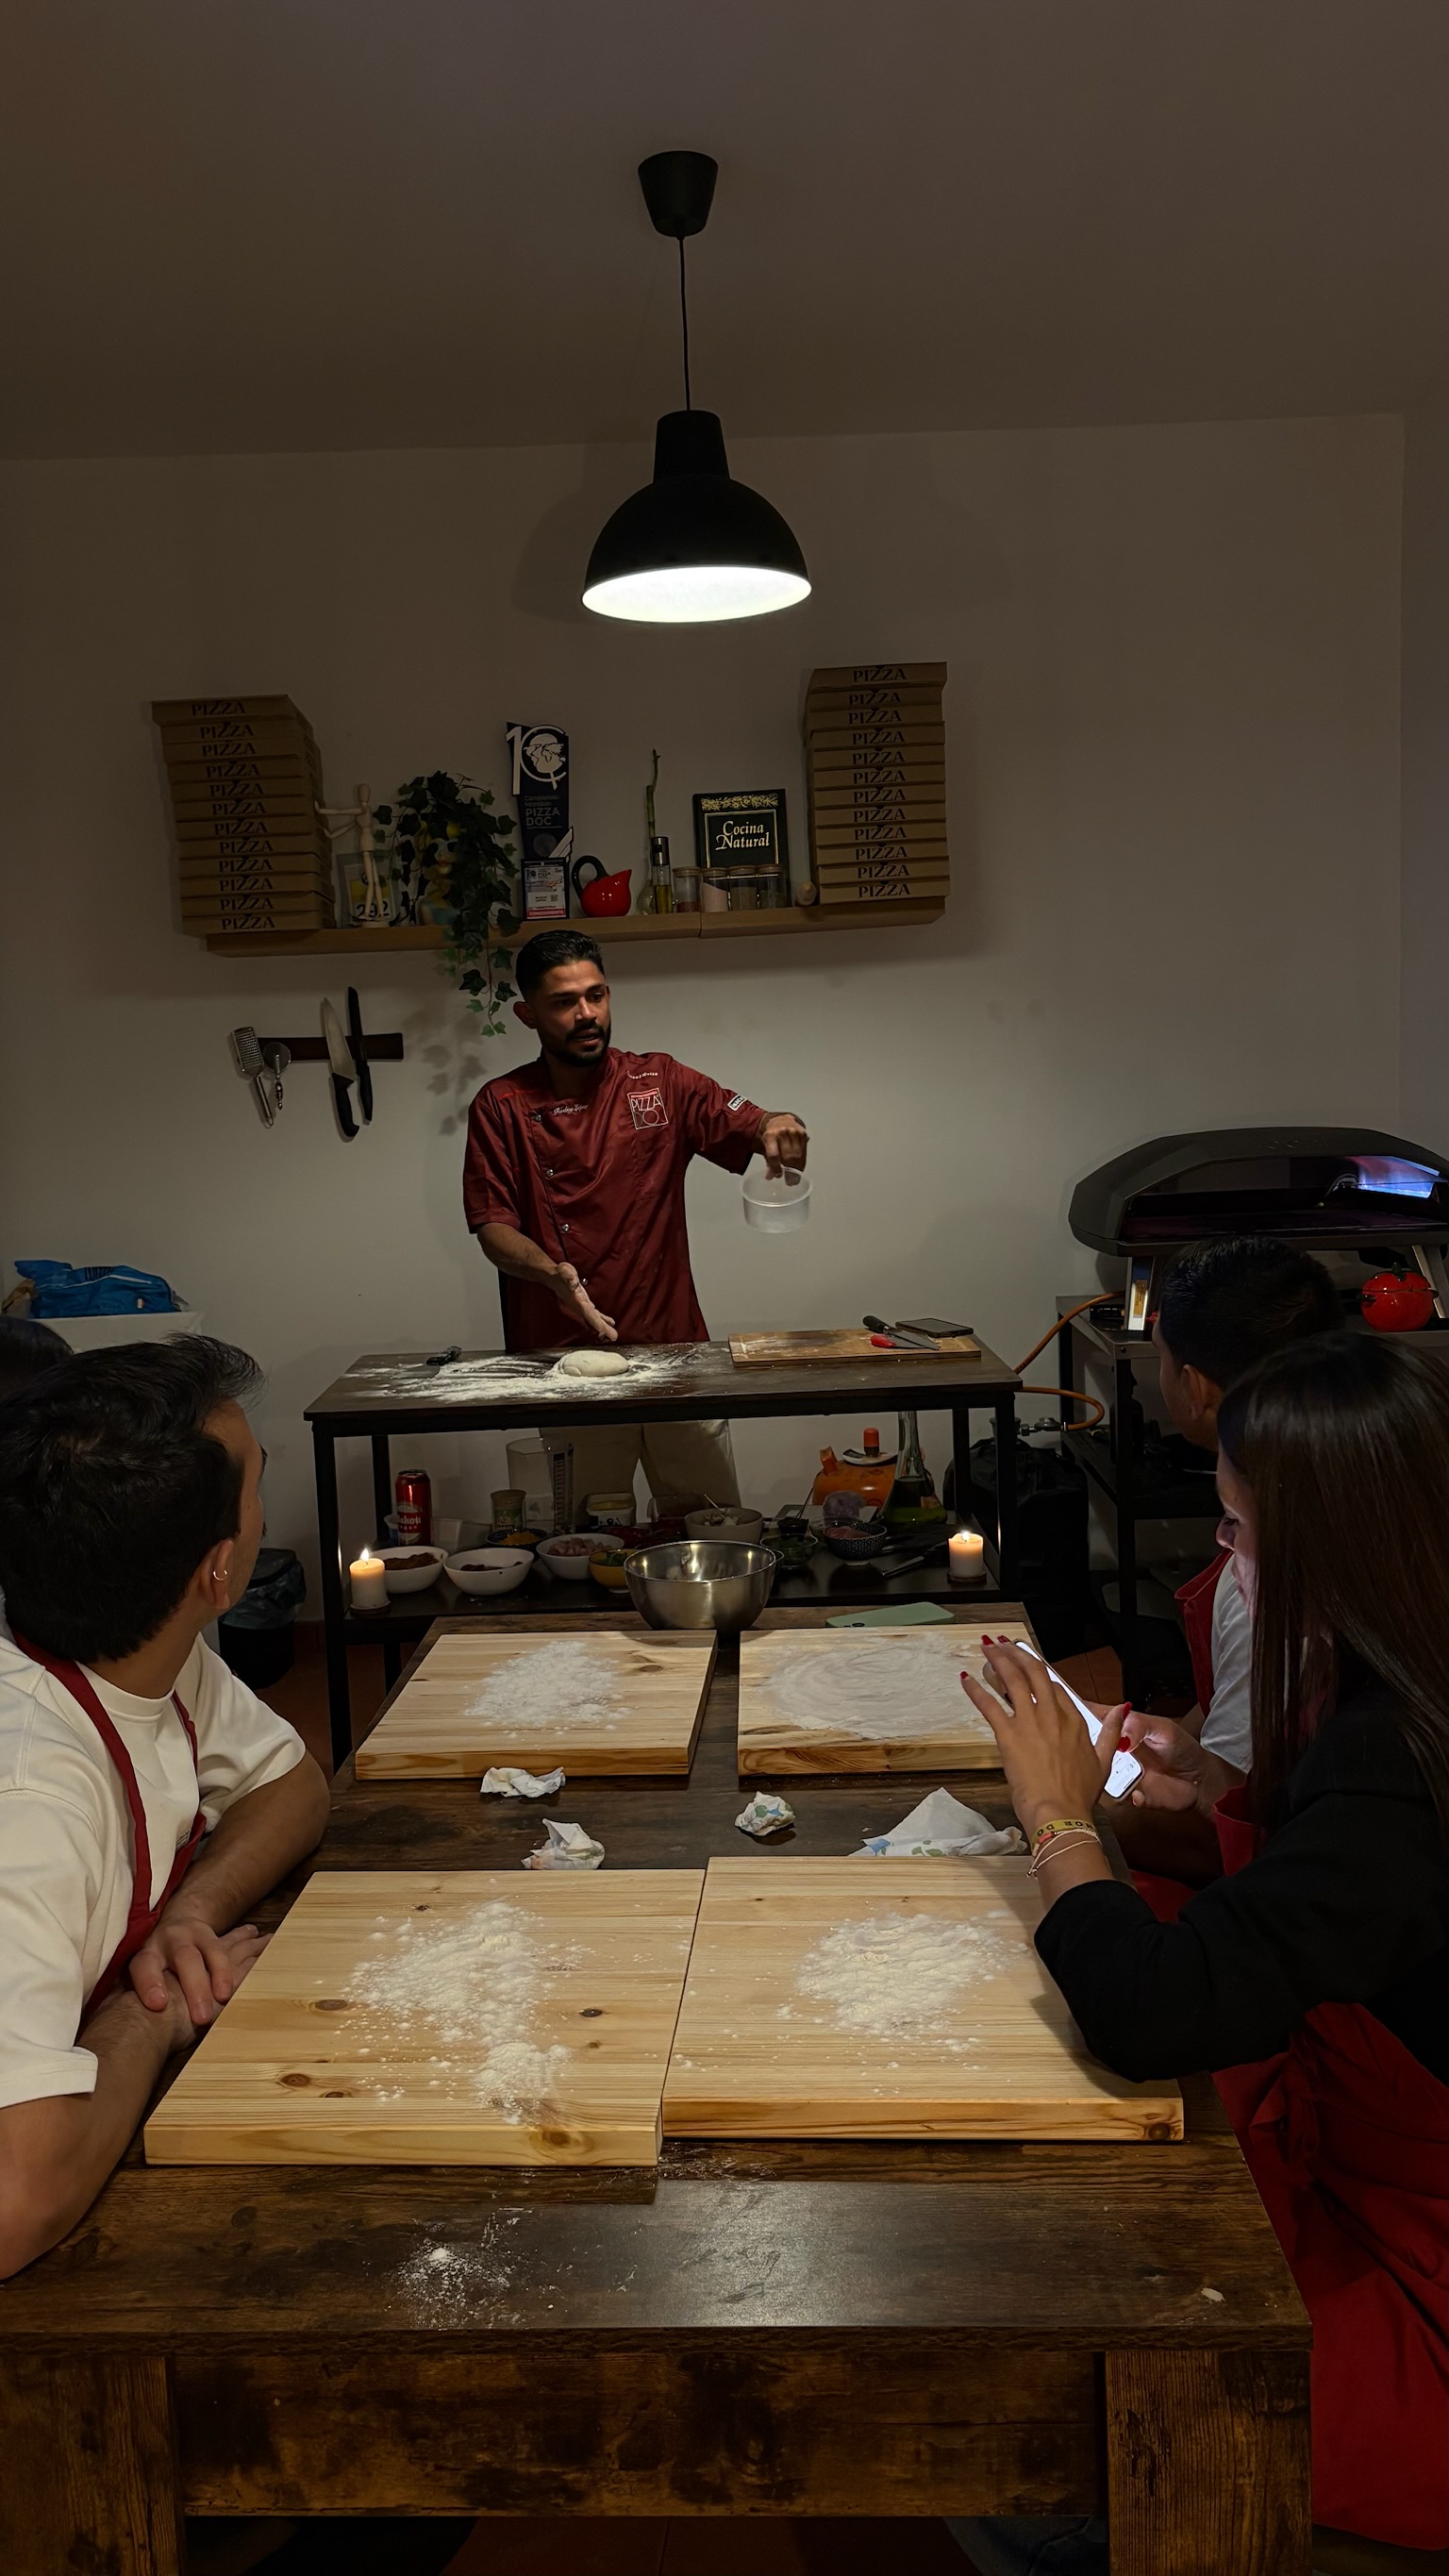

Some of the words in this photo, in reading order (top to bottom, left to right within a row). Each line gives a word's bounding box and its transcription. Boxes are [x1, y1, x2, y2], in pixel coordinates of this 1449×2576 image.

[853, 668, 907, 682] PIZZA
[849, 692, 902, 706] PIZZA
[192, 702, 246, 716] PIZZA
[849, 710, 903, 725] PIZZA
[200, 725, 254, 739] PIZZA
[852, 730, 906, 744] PIZZA
[202, 742, 257, 757] PIZZA
[852, 751, 906, 764] PIZZA
[206, 763, 260, 778] PIZZA
[853, 770, 907, 784] PIZZA
[209, 783, 264, 797] PIZZA
[853, 789, 907, 803] PIZZA
[212, 802, 266, 816] PIZZA
[525, 807, 560, 817] PIZZA
[853, 808, 907, 823] PIZZA
[214, 821, 268, 835] PIZZA
[525, 816, 552, 826] DOC
[723, 820, 764, 836] Cocina
[854, 827, 908, 841] PIZZA
[219, 840, 274, 854] PIZZA
[715, 832, 771, 851] Natural
[856, 846, 908, 860] PIZZA
[219, 859, 273, 873] PIZZA
[858, 864, 910, 878] PIZZA
[219, 878, 274, 892] PIZZA
[858, 883, 911, 898] PIZZA
[220, 897, 274, 912] PIZZA
[222, 916, 275, 930] PIZZA
[631, 1095, 663, 1112] PIZZA
